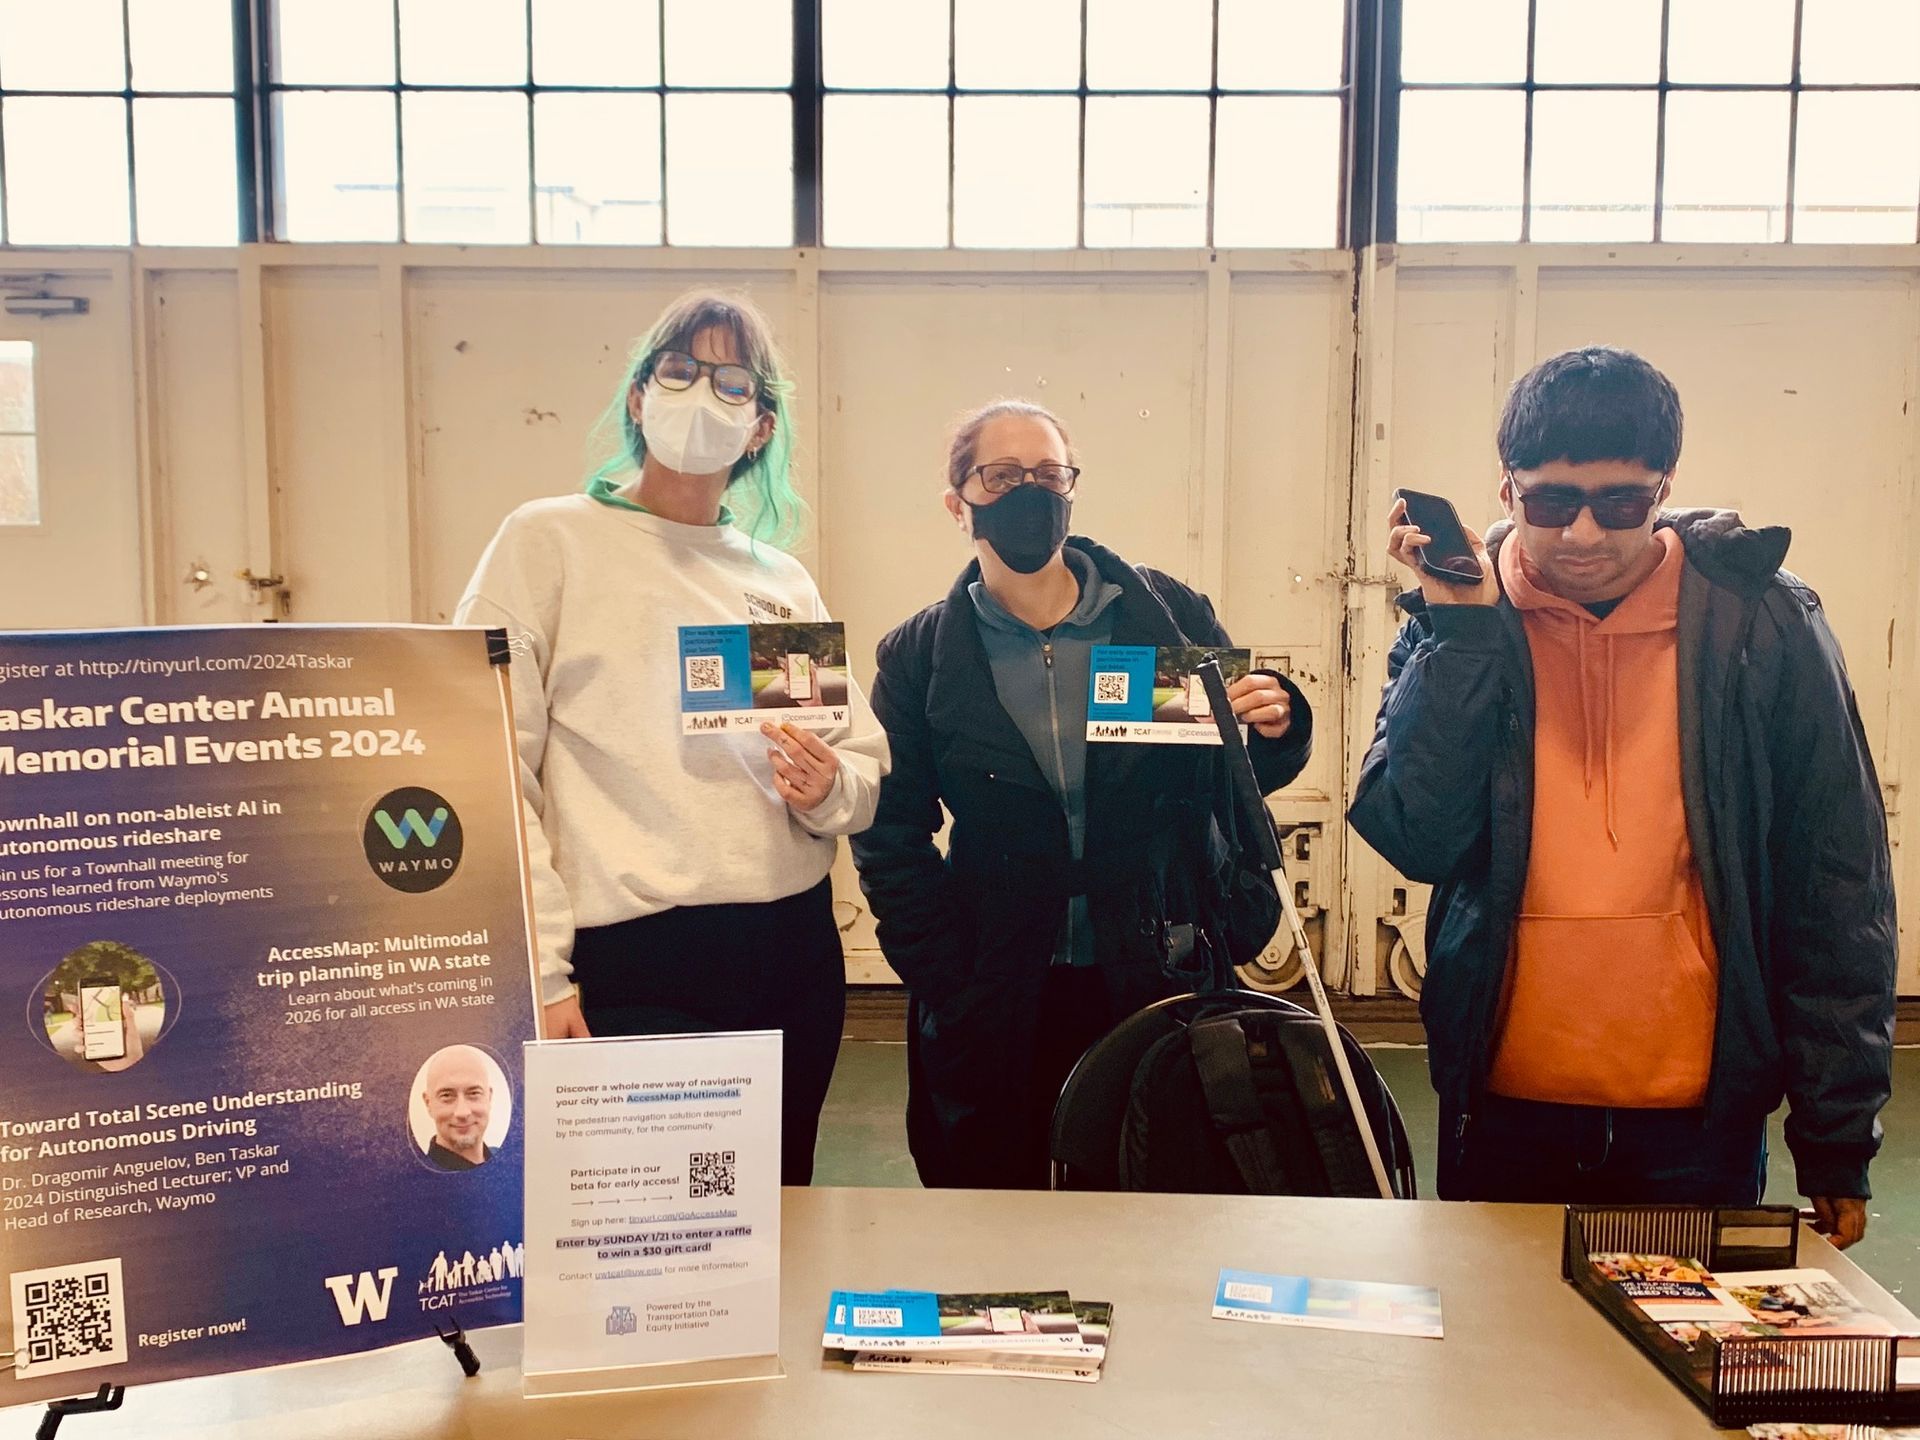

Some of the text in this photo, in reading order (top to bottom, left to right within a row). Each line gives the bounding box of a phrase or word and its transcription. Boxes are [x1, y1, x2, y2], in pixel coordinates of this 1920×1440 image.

[744, 592, 778, 616] SCHOOL
[780, 606, 792, 619] OF
[54, 662, 74, 677] at
[79, 653, 354, 679] http://tinyurl.com/2024Taskar
[0, 687, 396, 731] askar Center Annual
[832, 711, 844, 721] W
[184, 733, 323, 765] Events
[329, 729, 427, 758] 2024
[83, 813, 111, 827] on
[117, 801, 232, 824] non-ableist
[236, 800, 257, 816] AI
[261, 799, 282, 815] in
[0, 827, 221, 856] utonomous rideshare
[0, 851, 249, 881] in us for a Townhall meeting for
[378, 857, 453, 873] WAYMO
[0, 871, 229, 900] ssons learned from Waymo's
[96, 894, 170, 912] rideshare
[174, 885, 274, 908] deployments
[267, 929, 489, 963] AccessMap: Multimodal
[257, 953, 491, 988] trip planning in WA state
[288, 975, 493, 1007] Learn about what's coming in
[285, 993, 495, 1026] 2026 for all access in WA state
[556, 1085, 599, 1094] Discover
[610, 1082, 640, 1091] whole
[642, 1081, 663, 1089] new
[666, 1080, 686, 1089] way
[688, 1078, 698, 1087] of
[700, 1075, 752, 1086] navigating
[0, 1081, 363, 1138] Toward Total Scene Understanding
[556, 1099, 578, 1108] your
[580, 1096, 599, 1106] city
[601, 1095, 624, 1104] with
[626, 1093, 681, 1103] AccessMap
[557, 1108, 742, 1126] The pedestrian navigation solution designed
[0, 1118, 257, 1163] for Autonomous Driving
[556, 1130, 567, 1139] by
[569, 1129, 583, 1137] the
[2, 1144, 280, 1191] Dr. Dragomir Anguelov, Ben Taskar
[570, 1165, 661, 1178] Participate in our
[3, 1159, 290, 1211] 2024 Distinguished Lecturer; VP and
[570, 1176, 680, 1191] beta for early access!
[4, 1192, 216, 1231] Head of Research, Waymo
[570, 1218, 590, 1228] Sign
[591, 1218, 603, 1226] up
[556, 1239, 585, 1248] Enter
[587, 1238, 601, 1247] by
[603, 1234, 649, 1245] SUNDAY
[651, 1232, 669, 1242] 1/21
[671, 1232, 683, 1240] to
[685, 1230, 713, 1239] enter
[724, 1227, 752, 1236] raffle
[597, 1251, 609, 1259] to
[611, 1248, 631, 1258] win
[642, 1246, 662, 1256] $30
[664, 1245, 682, 1256] gift
[685, 1242, 712, 1253] card!
[558, 1272, 593, 1281] Contact
[664, 1265, 676, 1274] for
[678, 1264, 700, 1273] more
[701, 1261, 749, 1271] information
[325, 1266, 399, 1325] W
[419, 1292, 457, 1311] TCAT
[646, 1300, 711, 1311] Powered by the
[646, 1309, 729, 1322] Transportation Data
[646, 1320, 710, 1332] Equity Initiative
[138, 1318, 247, 1347] Register now!
